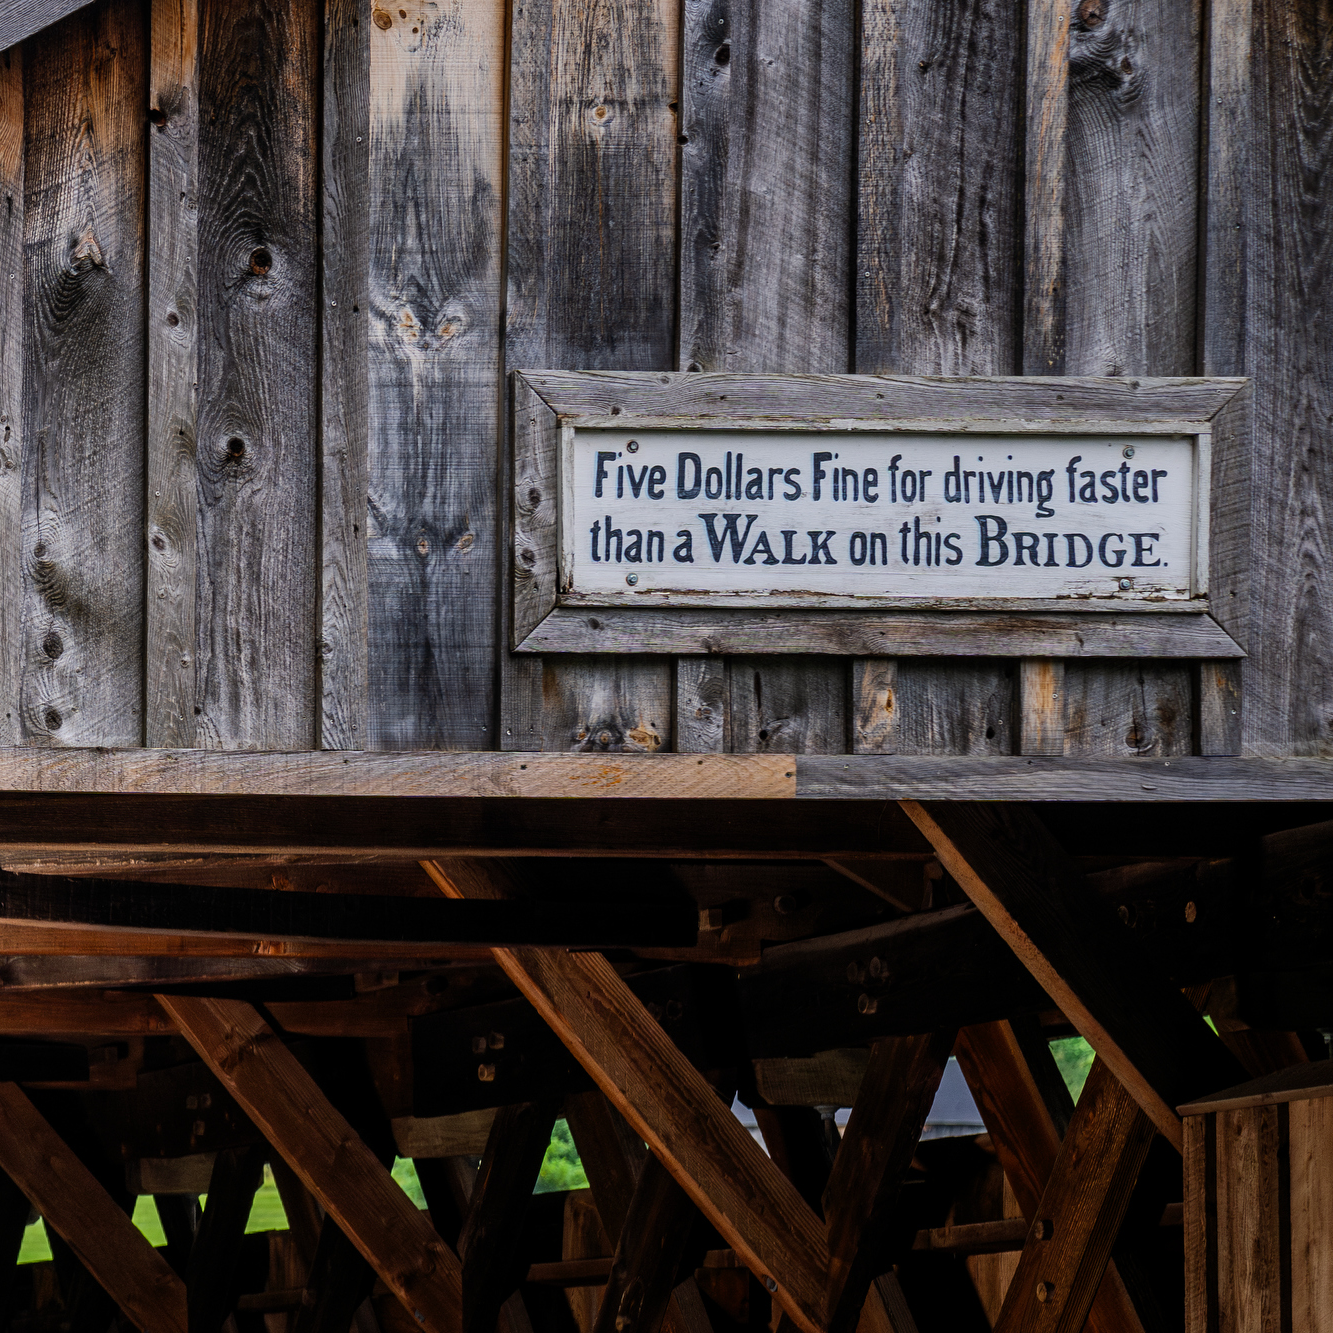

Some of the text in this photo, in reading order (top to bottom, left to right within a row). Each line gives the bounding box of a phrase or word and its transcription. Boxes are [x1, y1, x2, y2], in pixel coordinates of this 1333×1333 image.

[593, 450, 1169, 519] Five Dollars Fine for driving faster
[589, 512, 1169, 569] than a WALK on this BRIDGE.
